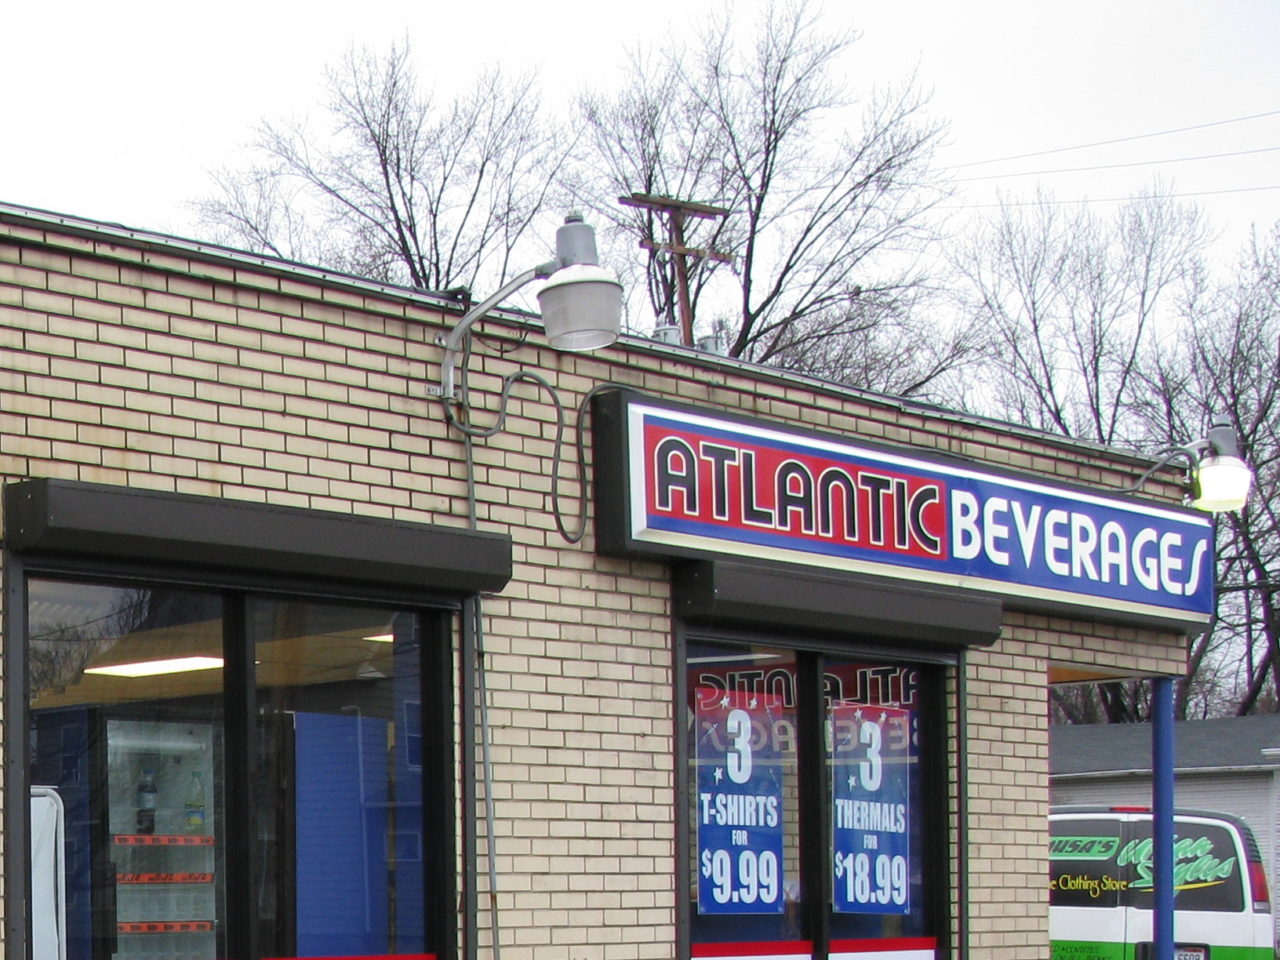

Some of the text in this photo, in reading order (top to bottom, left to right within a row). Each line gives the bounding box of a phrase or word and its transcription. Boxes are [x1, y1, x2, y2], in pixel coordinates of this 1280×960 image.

[653, 436, 1207, 597] ATLANTIC BEVERAGES
[727, 709, 752, 784] 3
[859, 721, 882, 792] 3
[700, 793, 778, 827] T-SHIRTS
[835, 799, 905, 833] THERMALS
[732, 830, 748, 846] FOR
[863, 834, 878, 850] FOR
[701, 849, 778, 904] $9.99
[835, 851, 907, 905] $18.99
[1059, 874, 1100, 897] Clothing
[1101, 875, 1127, 890] Store
